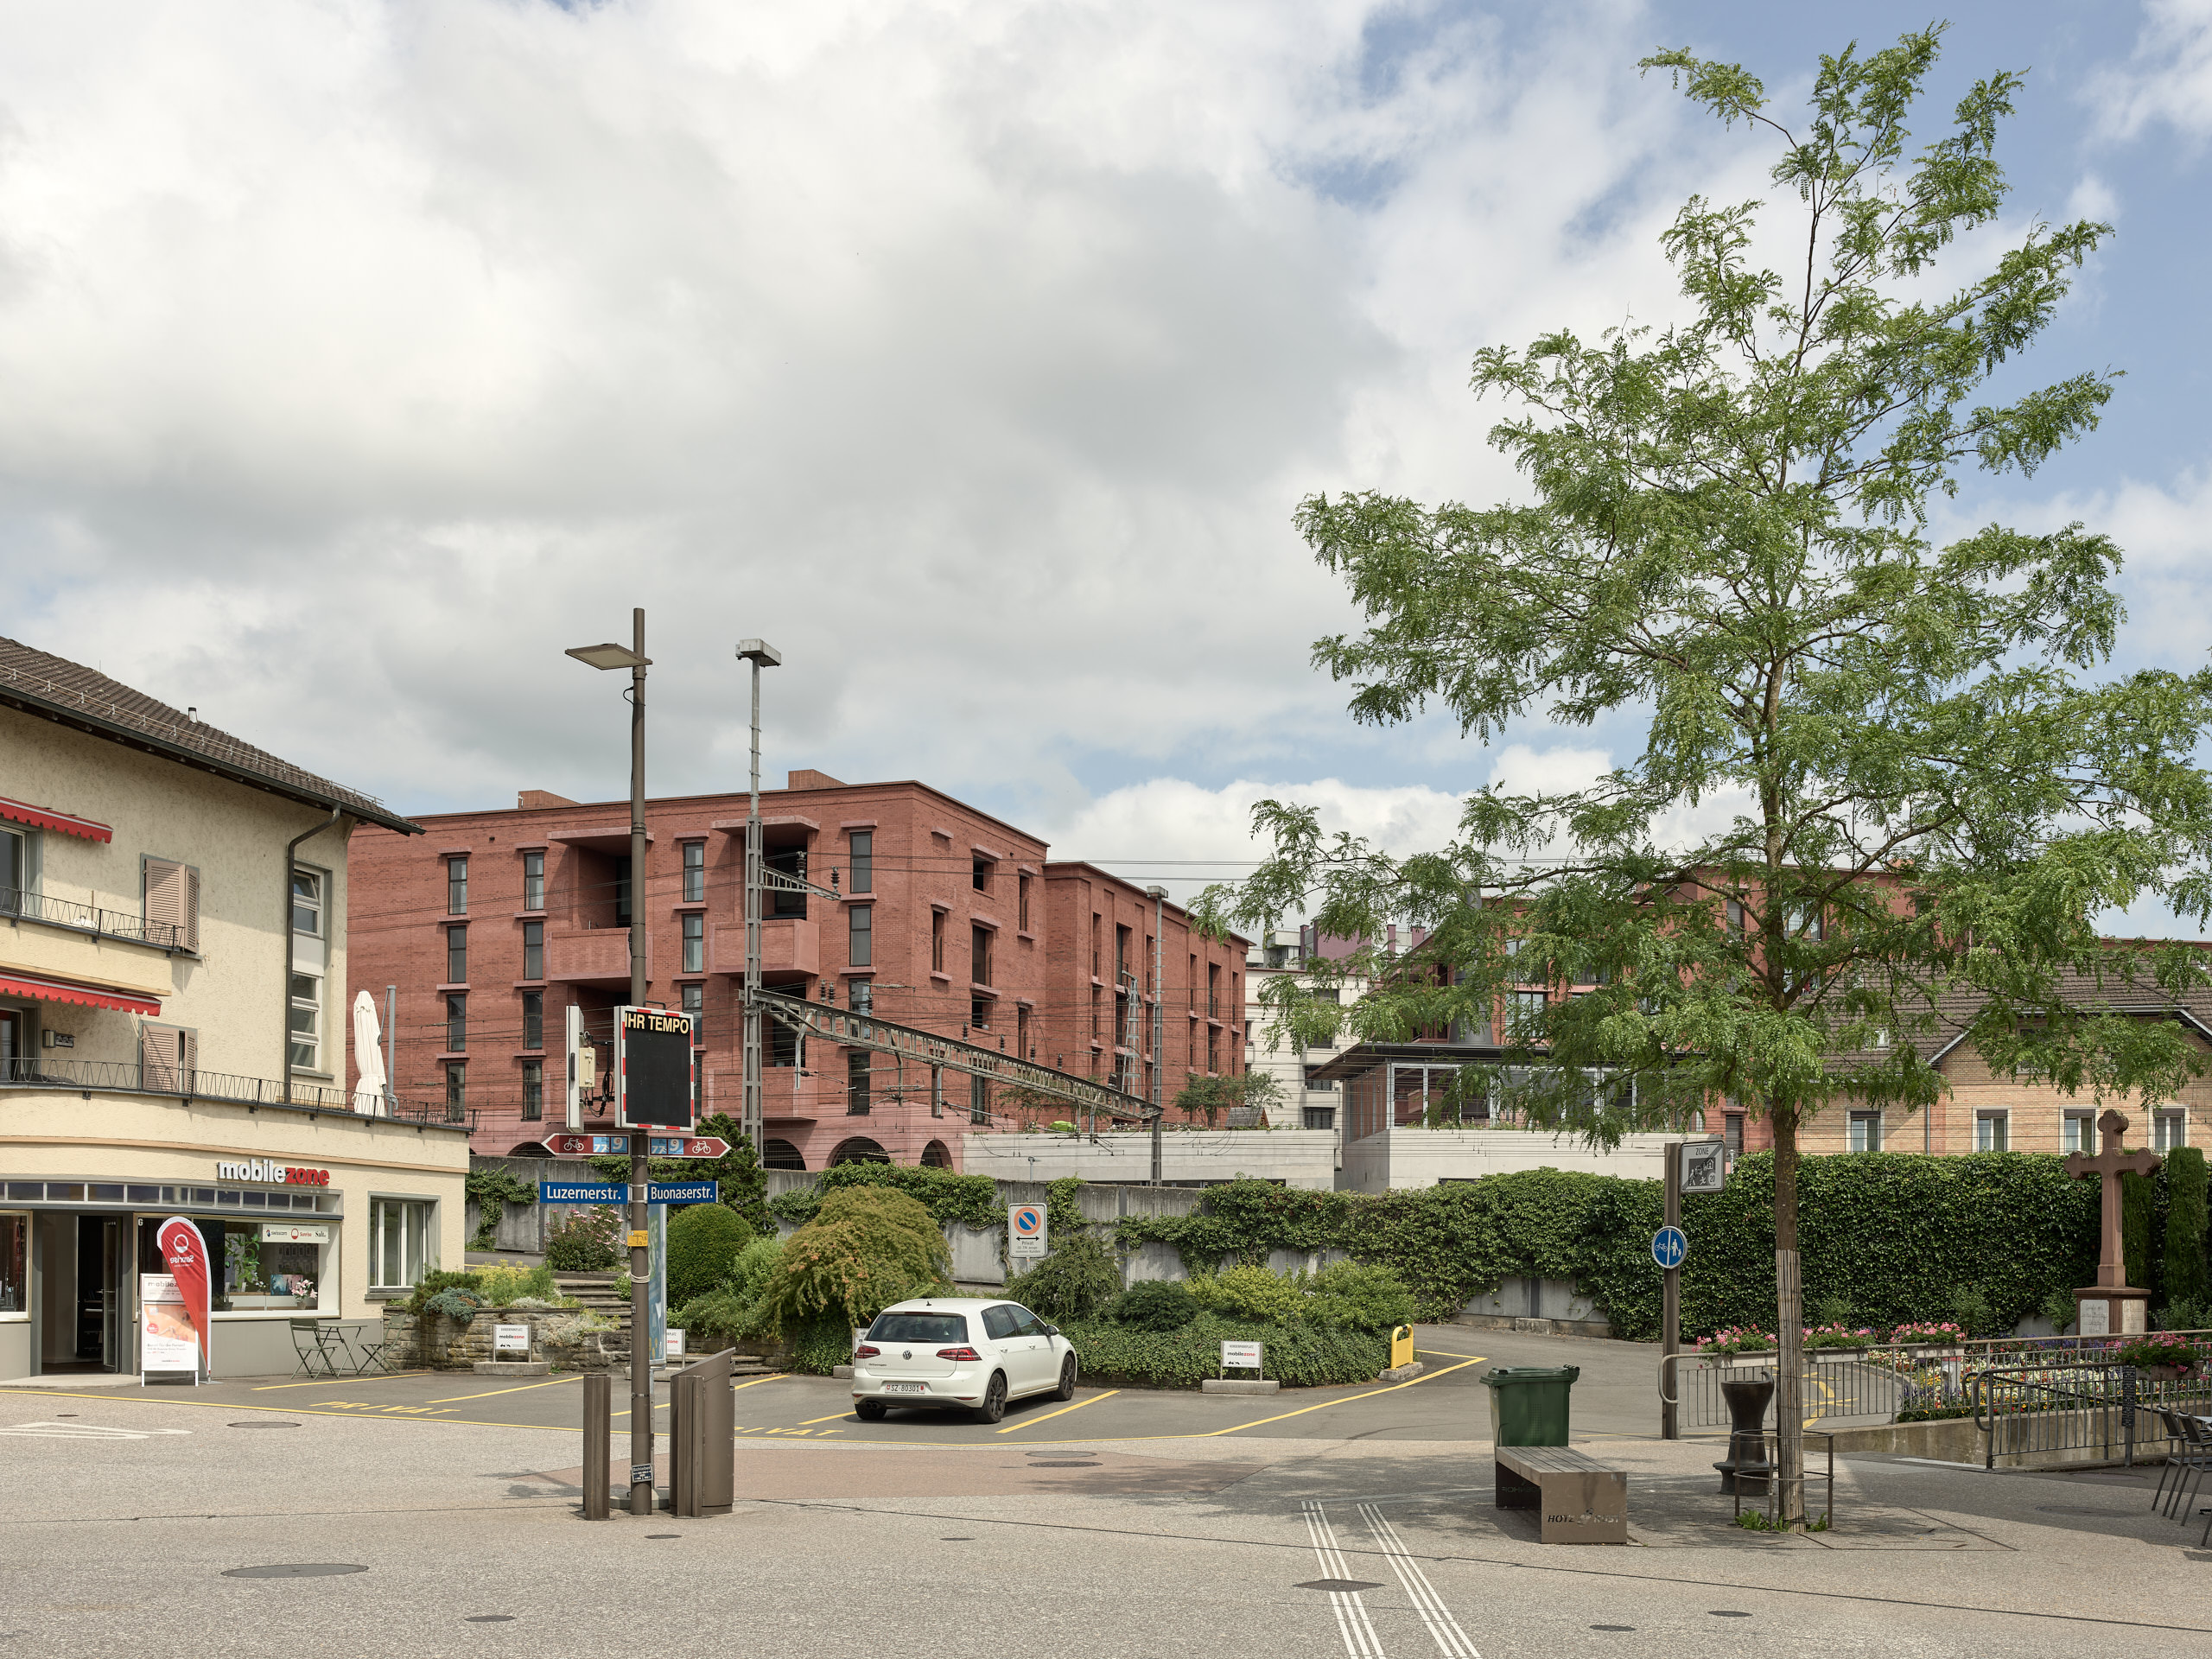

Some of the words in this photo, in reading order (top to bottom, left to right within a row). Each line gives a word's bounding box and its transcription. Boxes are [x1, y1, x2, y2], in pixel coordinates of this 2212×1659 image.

[625, 1012, 645, 1029] IHR
[648, 1015, 689, 1033] TEMPO
[594, 1143, 607, 1153] 77
[613, 1137, 623, 1149] 9
[652, 1146, 664, 1154] 77
[670, 1139, 679, 1151] 9
[1695, 1147, 1709, 1155] ZONE
[217, 1159, 330, 1186] mobilezone
[1709, 1174, 1715, 1183] 20
[547, 1185, 621, 1200] Luzernerstr.
[651, 1186, 714, 1200] Buonaserstr.
[308, 1401, 463, 1415] PRIVAT
[734, 1426, 844, 1436] IVAT
